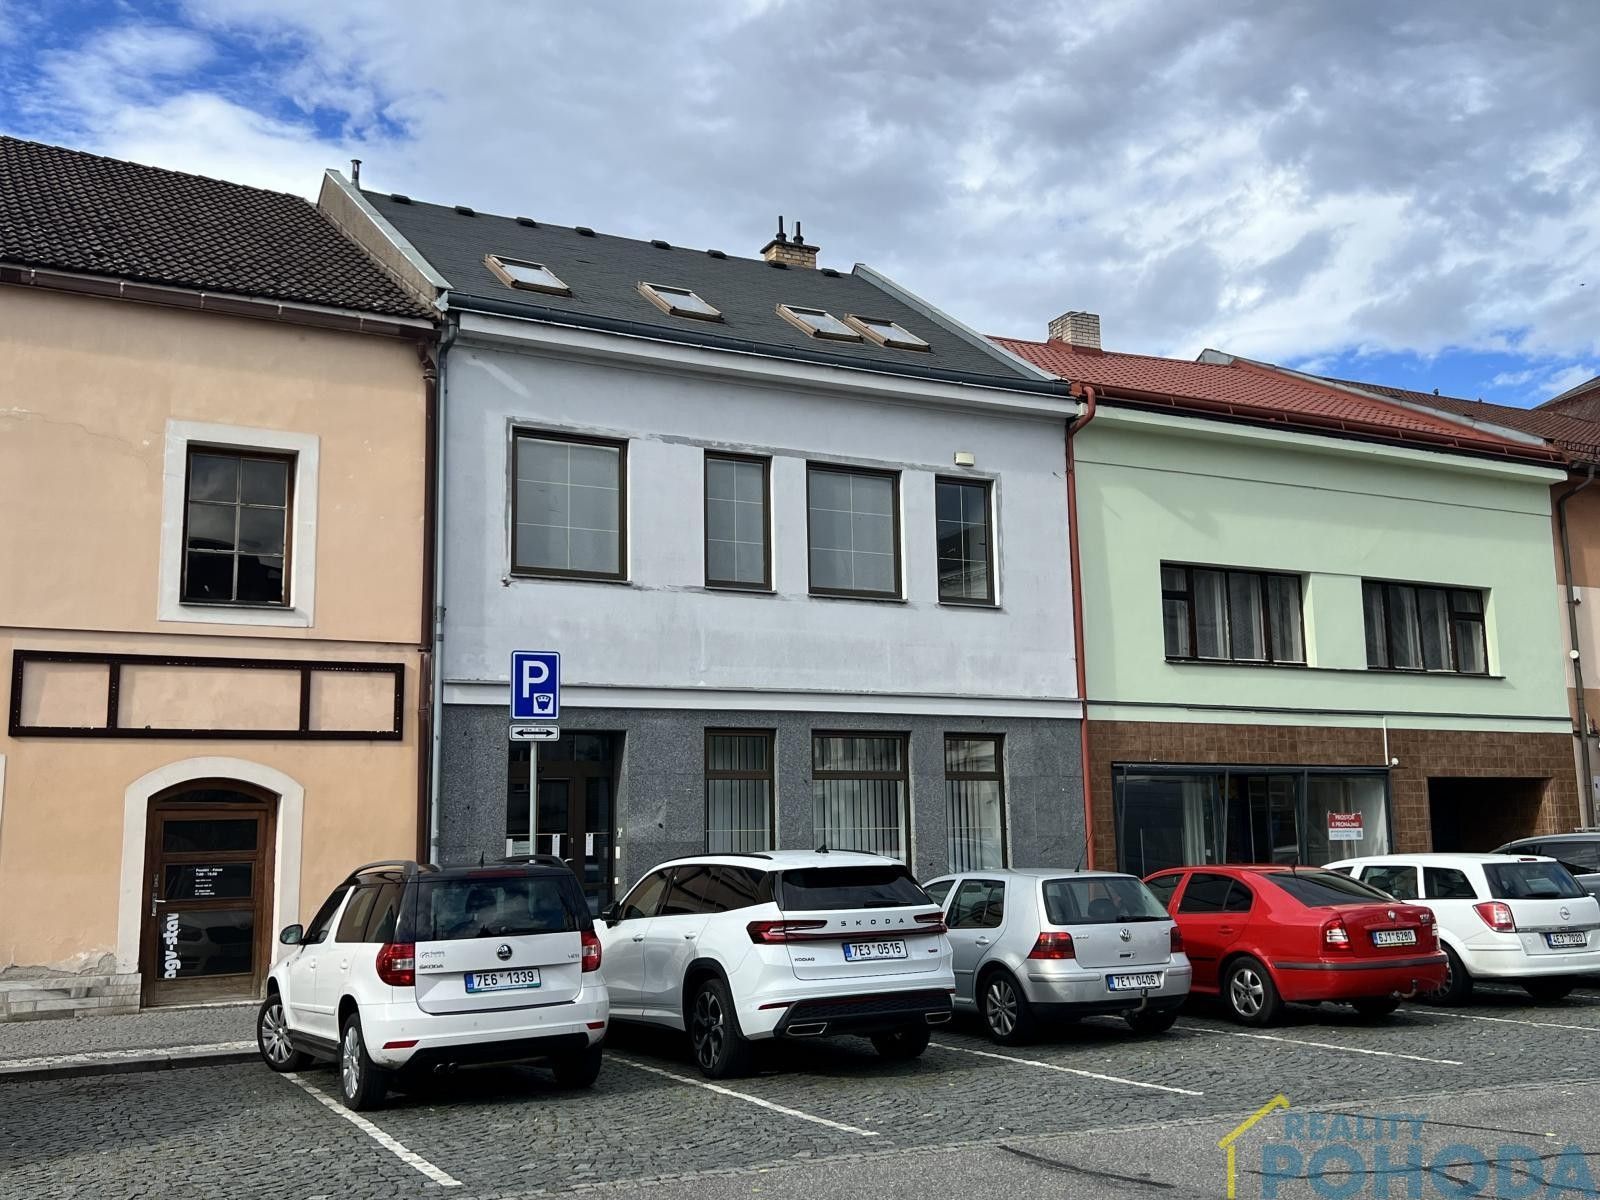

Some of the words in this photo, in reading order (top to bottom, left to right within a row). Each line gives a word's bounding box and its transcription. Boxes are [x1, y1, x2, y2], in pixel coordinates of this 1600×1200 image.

[522, 660, 549, 698] P
[163, 912, 181, 979] agv-stav
[852, 943, 872, 957] 7E3
[877, 942, 902, 955] 0515
[476, 974, 498, 987] 7E6
[506, 970, 534, 984] 1339
[1114, 976, 1132, 987] 7E1
[1136, 974, 1156, 986] 0406
